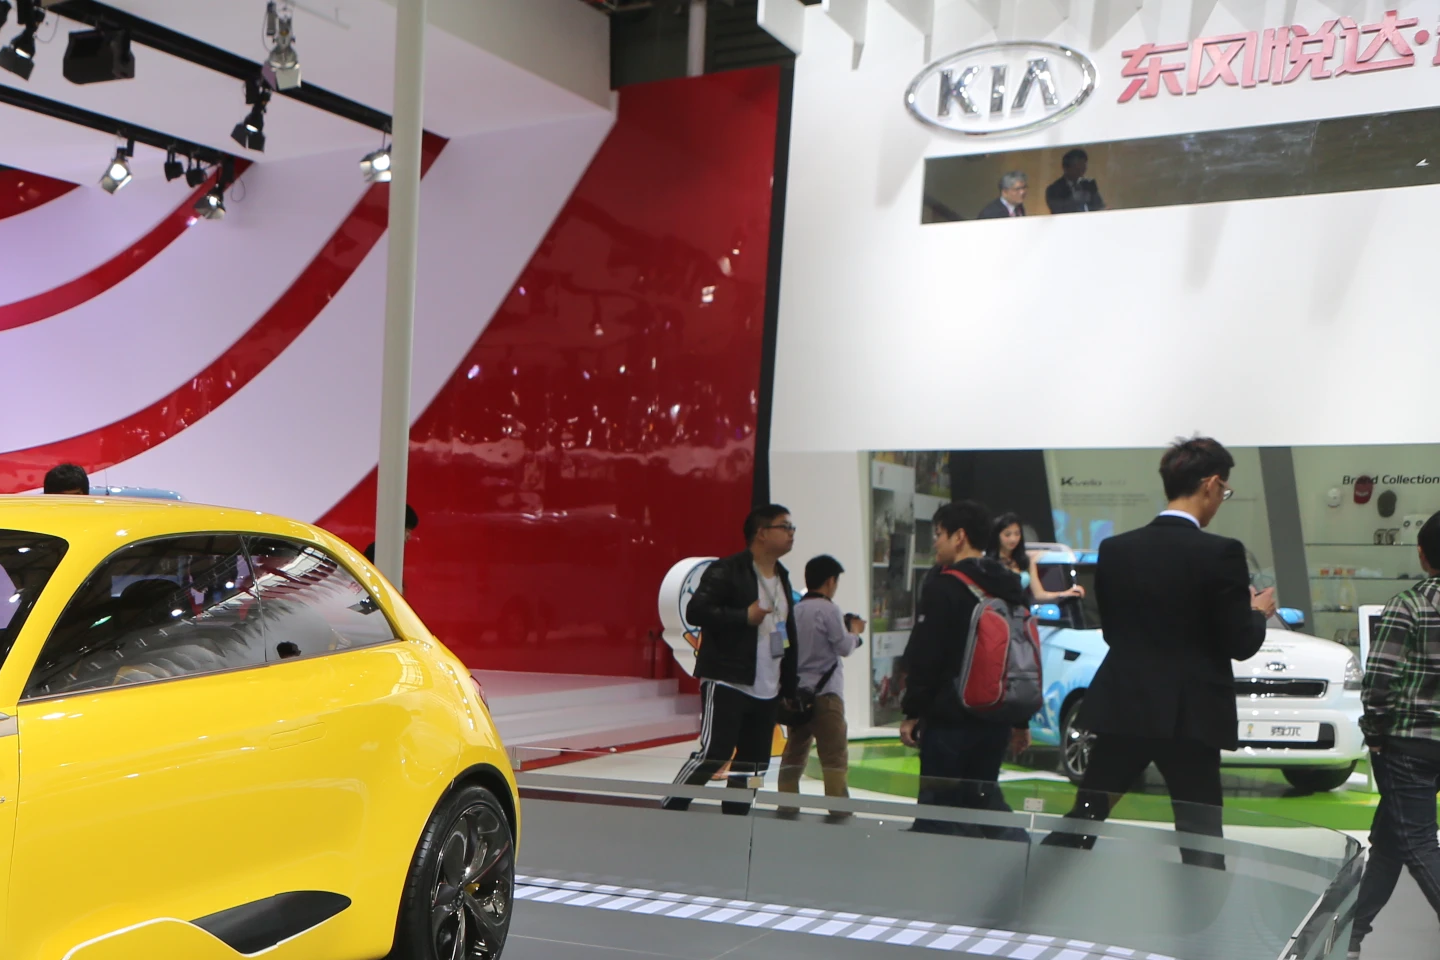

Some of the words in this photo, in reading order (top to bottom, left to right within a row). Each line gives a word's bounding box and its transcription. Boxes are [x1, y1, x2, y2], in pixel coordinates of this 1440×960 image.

[936, 56, 1060, 118] KIA
[1342, 475, 1379, 485] Brd
[1382, 474, 1440, 485] Collection
